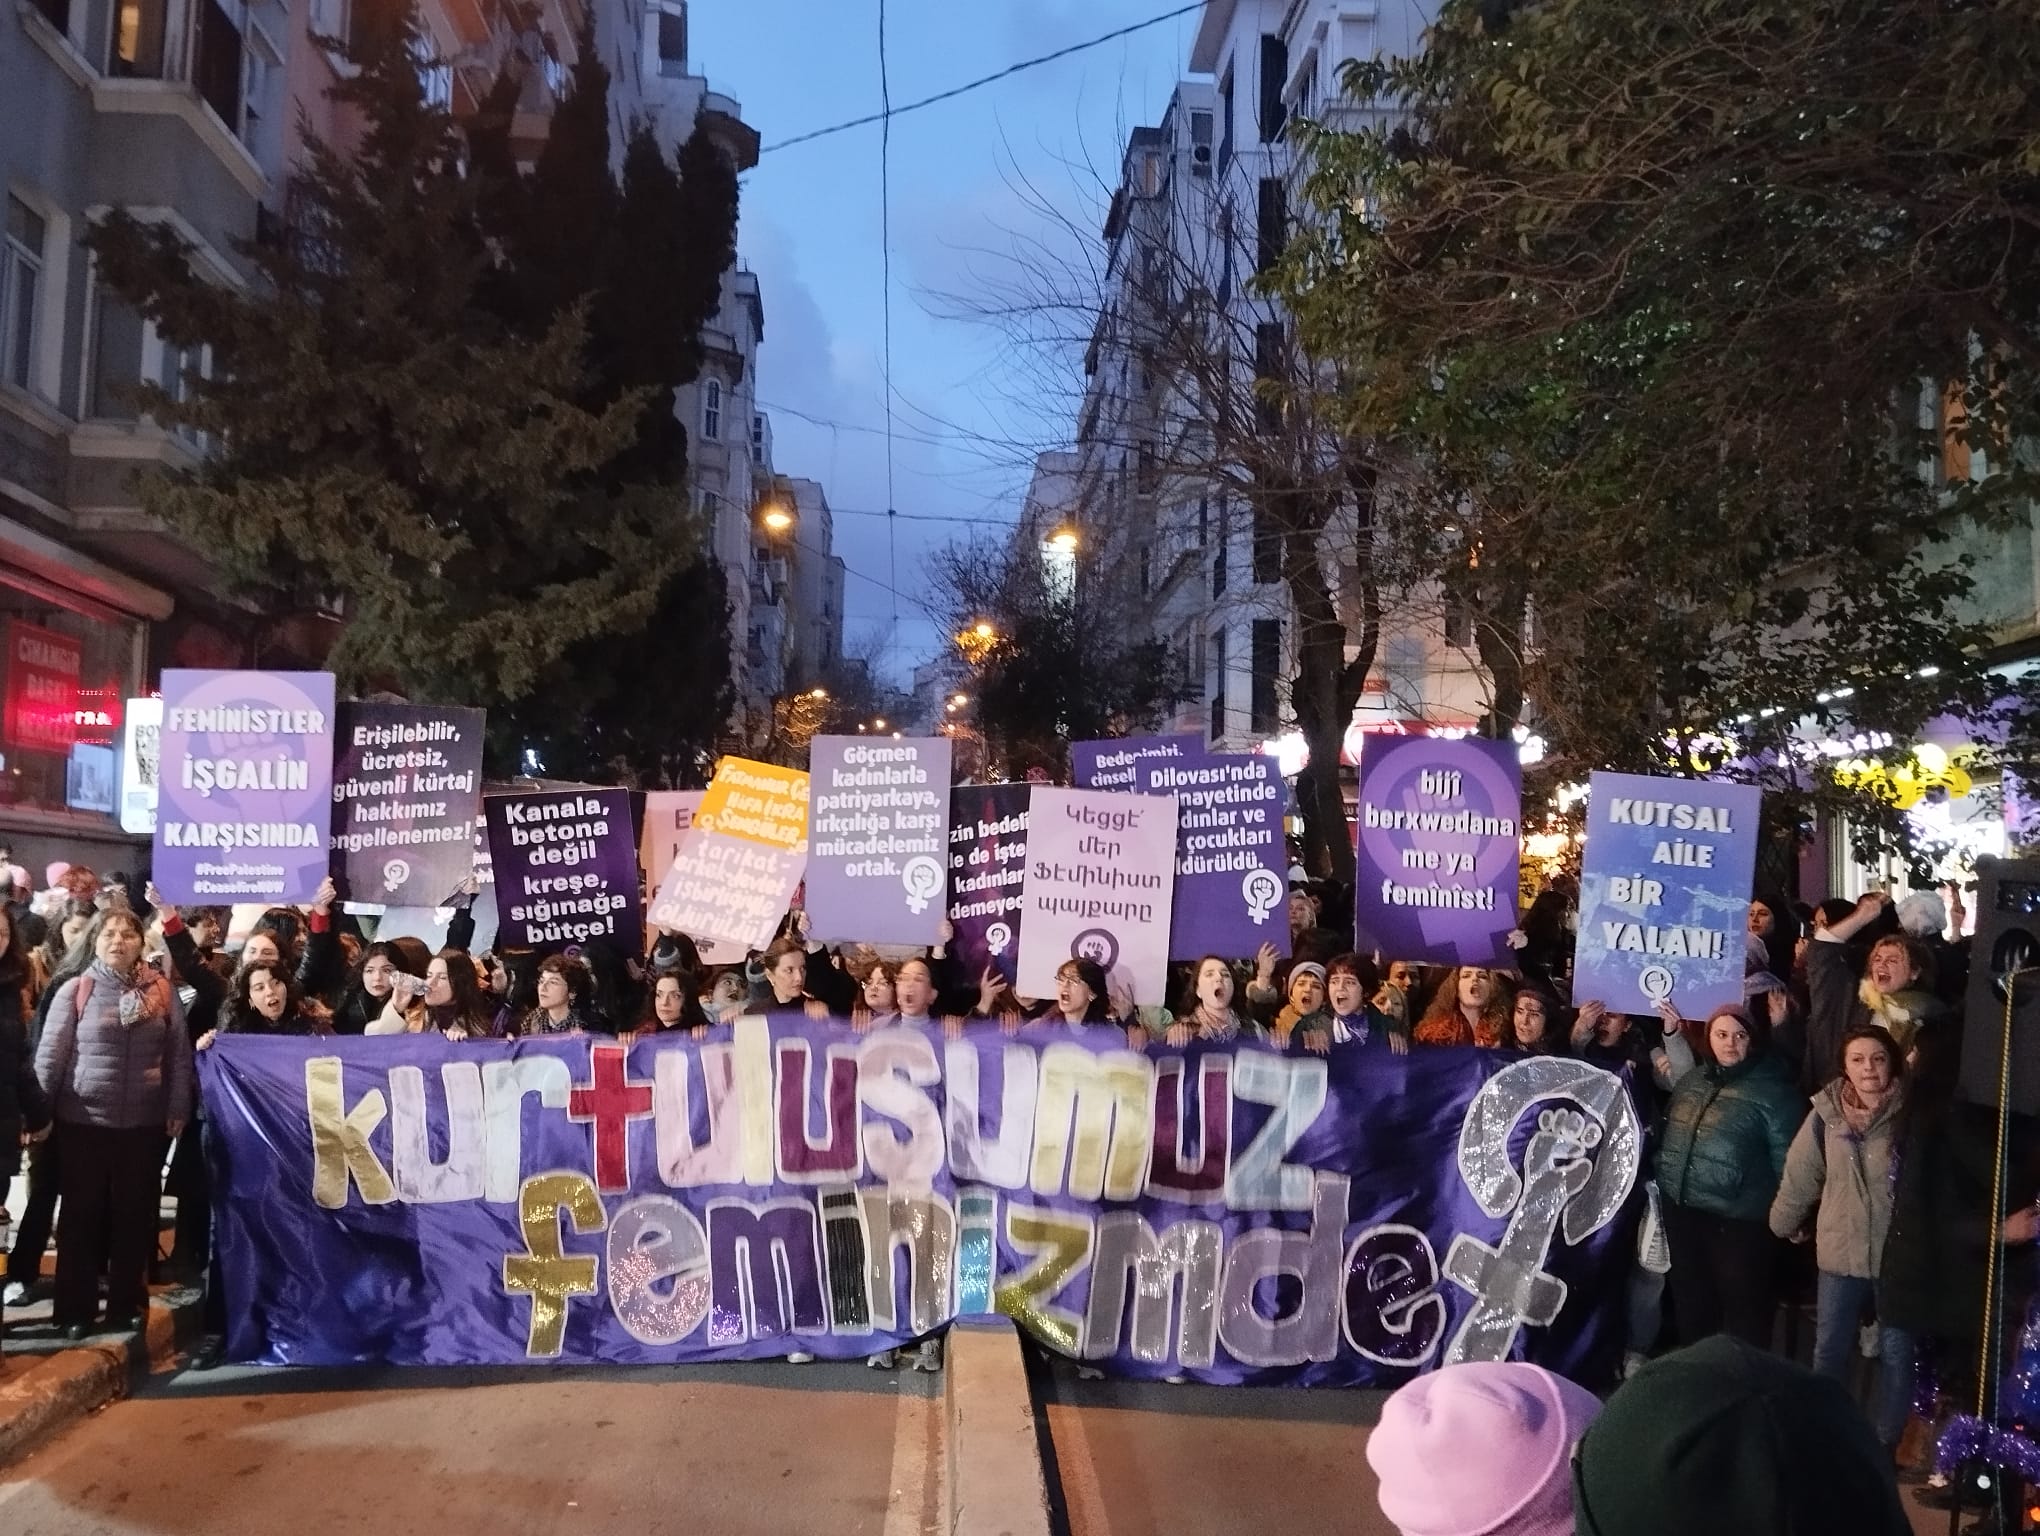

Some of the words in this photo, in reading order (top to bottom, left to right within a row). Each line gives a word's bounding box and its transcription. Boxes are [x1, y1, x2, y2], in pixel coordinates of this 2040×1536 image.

[169, 704, 325, 734] FEMİNİSTLER
[353, 720, 461, 750] Erişilebilir,
[361, 747, 448, 771] ücretsiz,
[843, 745, 918, 768] Göçmen
[182, 752, 308, 797] İŞGALİN
[333, 775, 407, 802] güvenli
[413, 769, 473, 793] kürtaj
[832, 765, 927, 787] kadınlarla
[1150, 759, 1267, 788] Dilovası'nda
[1421, 768, 1462, 801] bijî
[354, 800, 446, 822] hakkımız
[505, 796, 610, 825] Kanala,
[817, 787, 941, 814] patriyarkaya,
[816, 812, 890, 836] ırkçılığa
[895, 810, 940, 832] karşı
[1242, 808, 1266, 824] ve
[1365, 802, 1515, 836] berxwedana
[1609, 798, 1734, 834] KUTSAL
[163, 822, 320, 853] KARŞISINDA
[328, 821, 472, 853] engellenemez!
[511, 820, 609, 846] betona
[816, 833, 939, 856] mücadelemiz
[1186, 827, 1272, 855] çocukları
[528, 838, 597, 866] değil
[968, 847, 990, 866] de
[993, 842, 1026, 865] işte
[1079, 836, 1121, 860] մեր
[1402, 848, 1440, 869] me
[1446, 851, 1475, 875] ya
[1651, 838, 1714, 868] AİLE
[845, 857, 901, 877] ortak.
[954, 867, 1025, 894] kadınlar
[523, 873, 608, 896] kreşe,
[1381, 878, 1495, 911] femînîst!
[1609, 872, 1663, 906] BİR
[510, 891, 627, 922] sığınağa
[526, 915, 614, 944] bütçe!
[1601, 921, 1724, 960] YALAN!
[503, 1168, 1446, 1369] feminizmde
